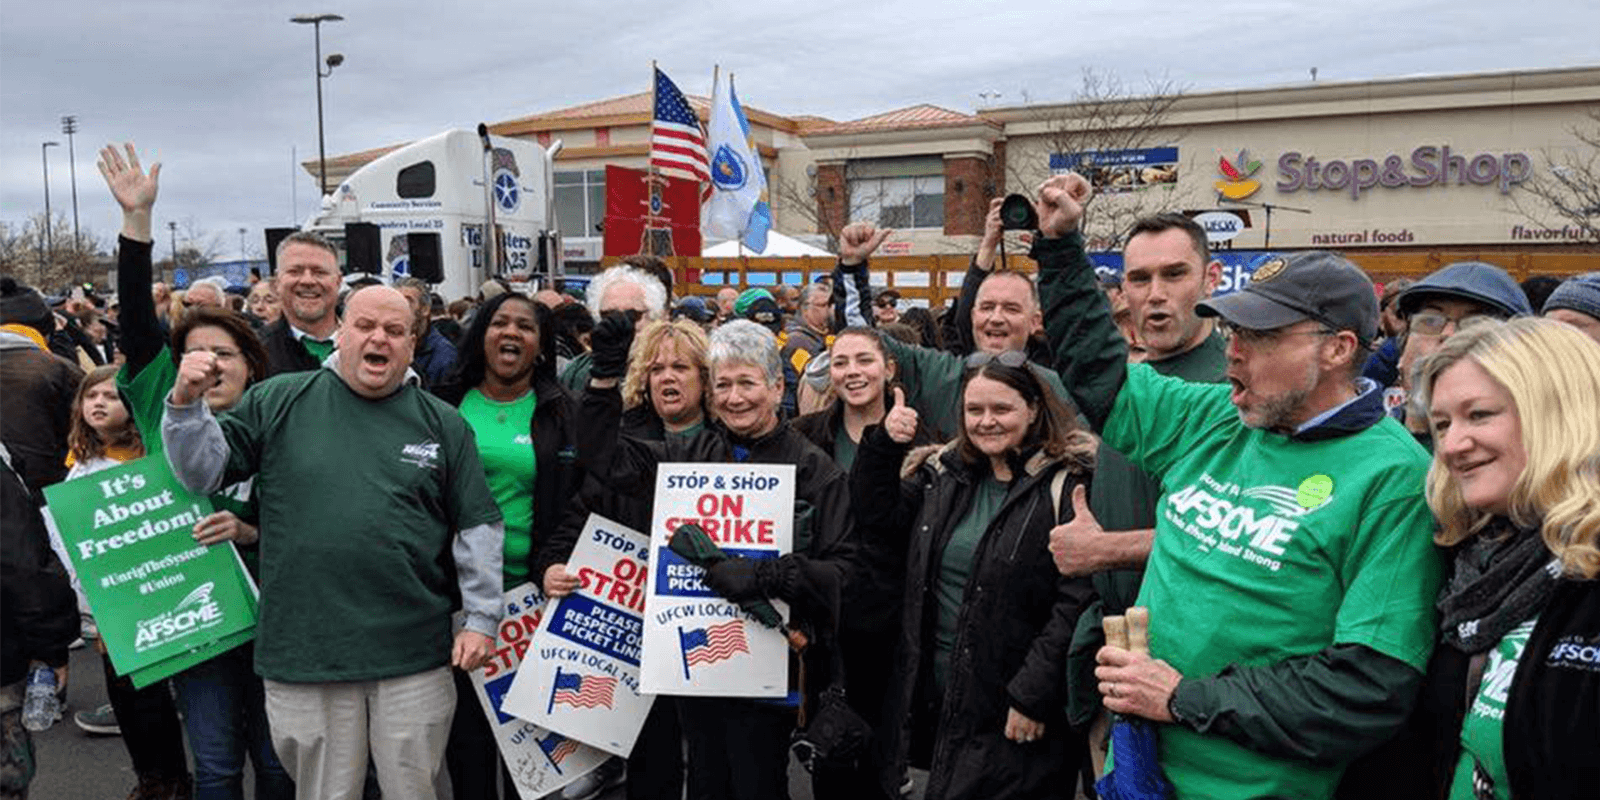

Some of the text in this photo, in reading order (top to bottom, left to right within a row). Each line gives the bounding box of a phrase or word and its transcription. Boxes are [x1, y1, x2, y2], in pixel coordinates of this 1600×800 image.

[1276, 146, 1530, 200] Stop&Shop
[411, 200, 442, 208] Services
[409, 219, 431, 229] Local
[1311, 228, 1415, 245] natural foods
[1511, 225, 1584, 240] flavorful
[510, 251, 527, 270] 25
[1217, 265, 1252, 291] Sh
[99, 473, 146, 499] It's
[667, 474, 780, 490] STOP & SHOP
[93, 489, 175, 530] About
[696, 493, 745, 518] ON
[76, 503, 203, 560] Freedom!
[1167, 485, 1300, 556] AFSCME
[591, 528, 635, 553] STOP
[666, 564, 708, 577] RESP
[1242, 548, 1282, 572] Strong
[139, 572, 186, 595] #Union
[577, 566, 646, 613] STRI
[668, 578, 711, 591] PICK
[507, 591, 544, 615] & SH
[656, 604, 695, 625] UFCW
[135, 601, 223, 648] AFSCME
[564, 609, 625, 640] RESPECT
[591, 605, 641, 634] PLEASE
[562, 621, 612, 650] PICKET
[540, 648, 580, 661] UFCW
[581, 653, 620, 678] LOCAL
[510, 722, 538, 745] UFC
